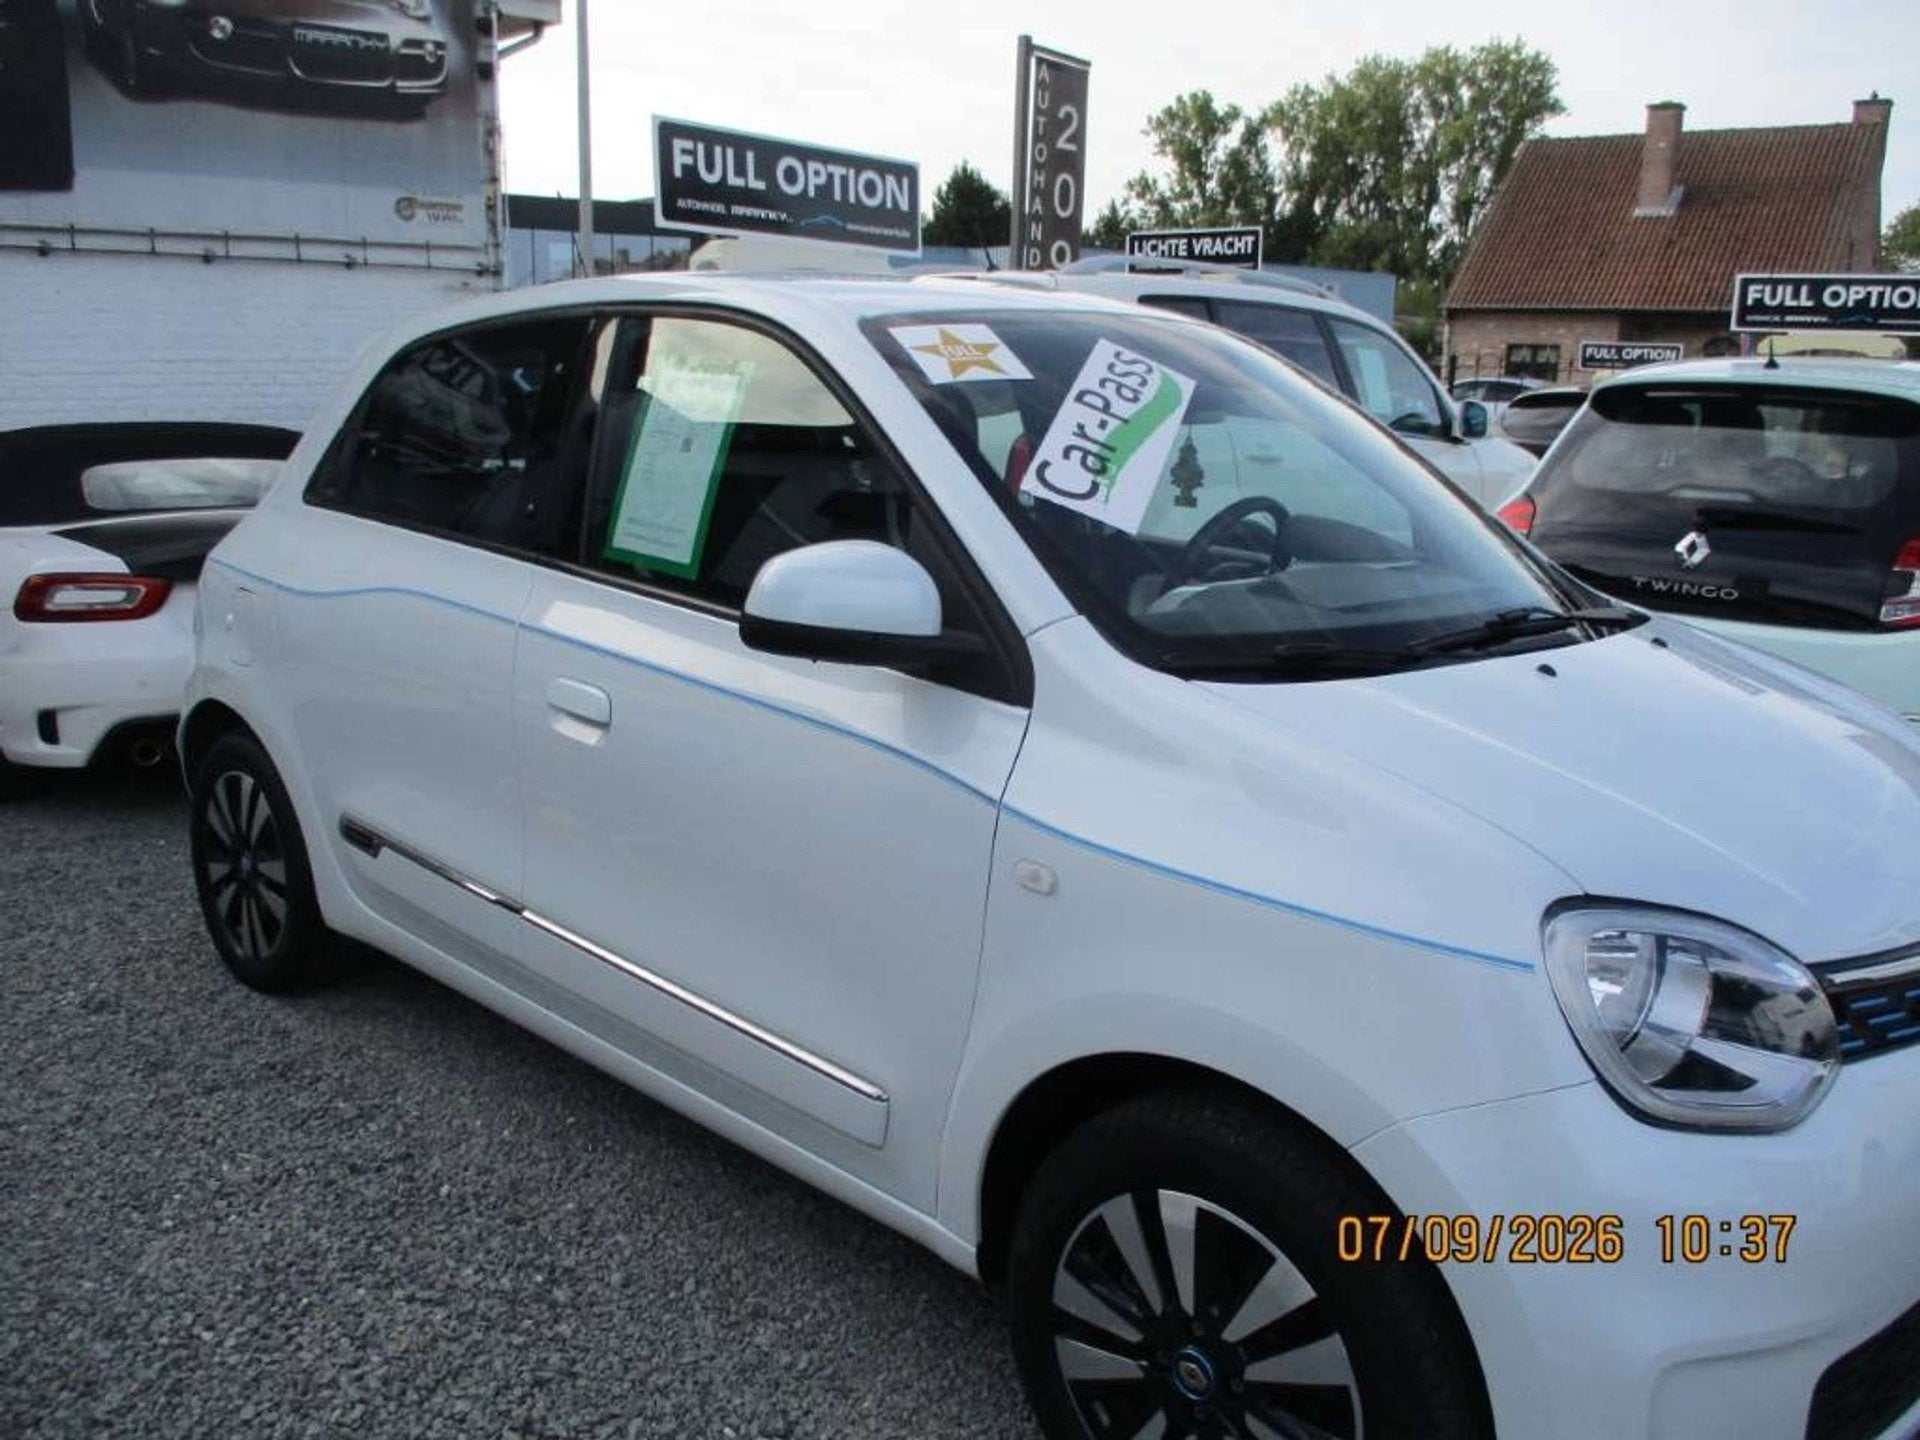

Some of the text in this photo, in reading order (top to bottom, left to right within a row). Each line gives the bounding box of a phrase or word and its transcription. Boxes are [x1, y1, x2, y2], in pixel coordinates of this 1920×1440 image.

[672, 138, 910, 211] FULL OPTION
[1134, 235, 1255, 257] LICHTE VRACHT
[1746, 284, 1920, 309] FULL OPTIO
[1585, 347, 1677, 361] FULL OPTION
[1034, 349, 1155, 502] Car-Pass
[1632, 575, 1740, 600] TWINGO
